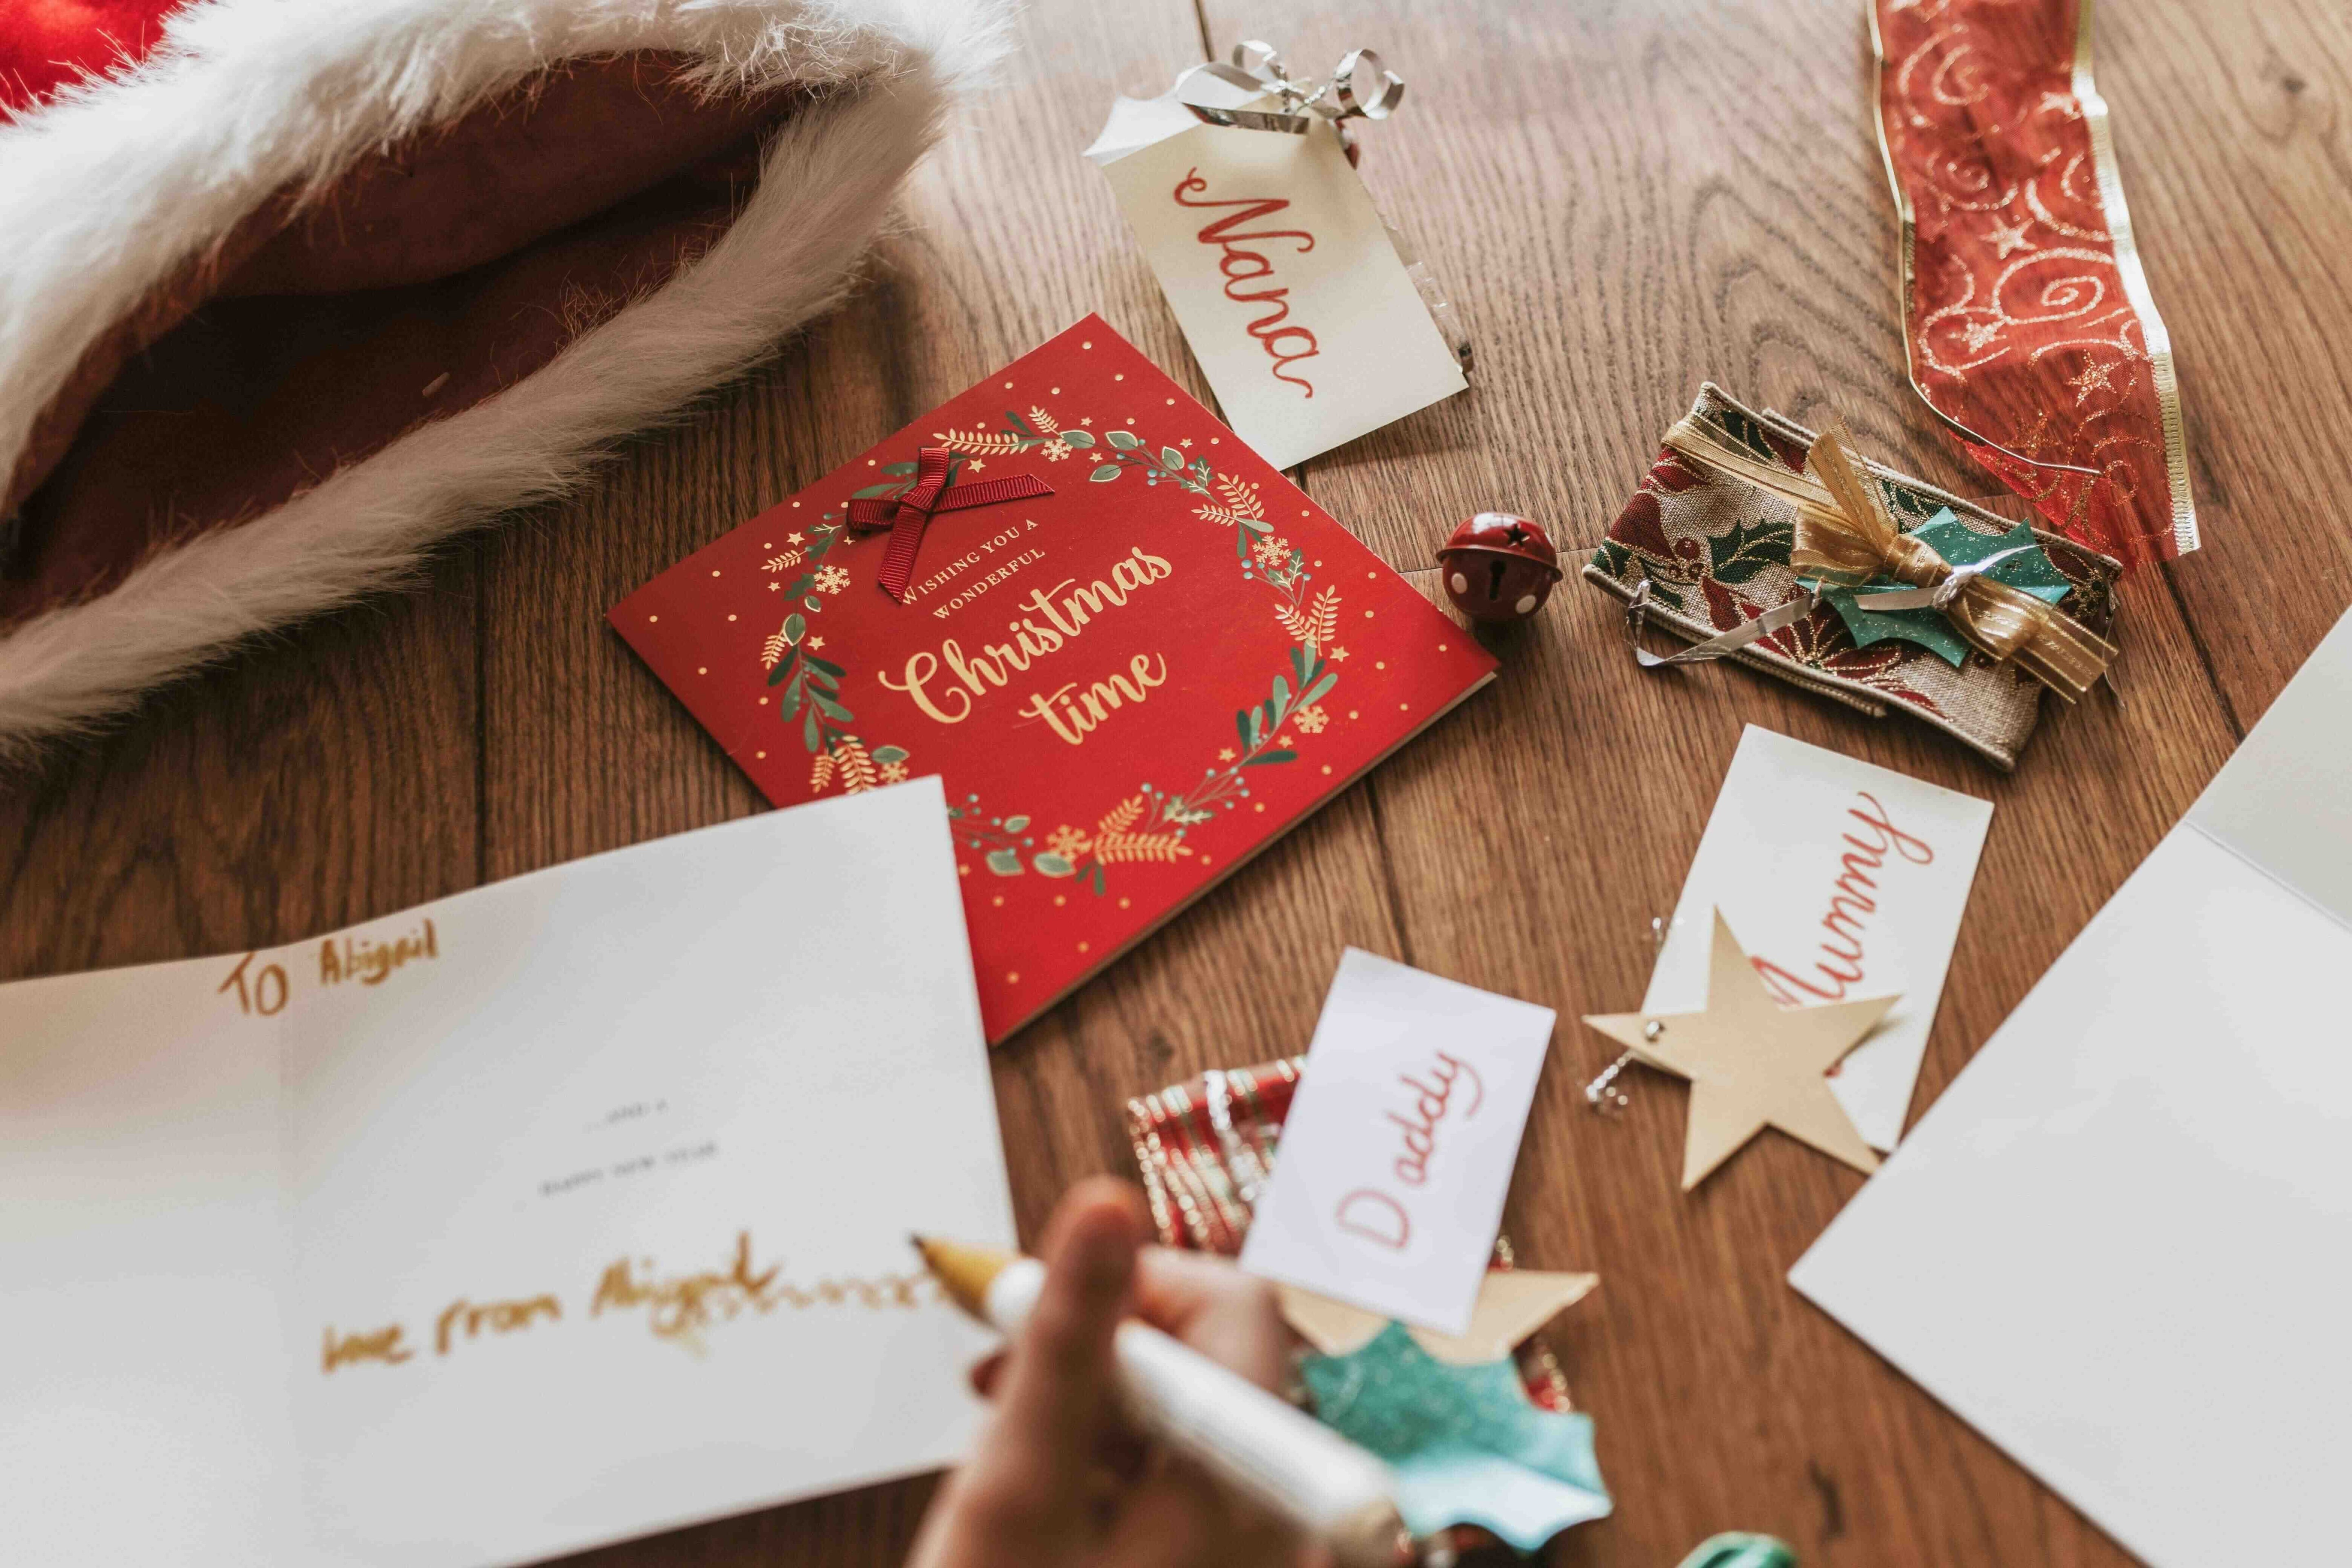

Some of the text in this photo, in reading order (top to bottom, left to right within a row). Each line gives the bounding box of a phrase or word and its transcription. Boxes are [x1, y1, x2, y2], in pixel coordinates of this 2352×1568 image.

[1174, 166, 1320, 398] Nana
[903, 518, 1039, 605] WISHING YOU A
[932, 548, 1045, 619] WONDERFUL
[878, 546, 1172, 724] Christmas
[1018, 652, 1167, 745] time
[318, 917, 439, 985] Abigail
[1335, 1050, 1484, 1252] Daddy
